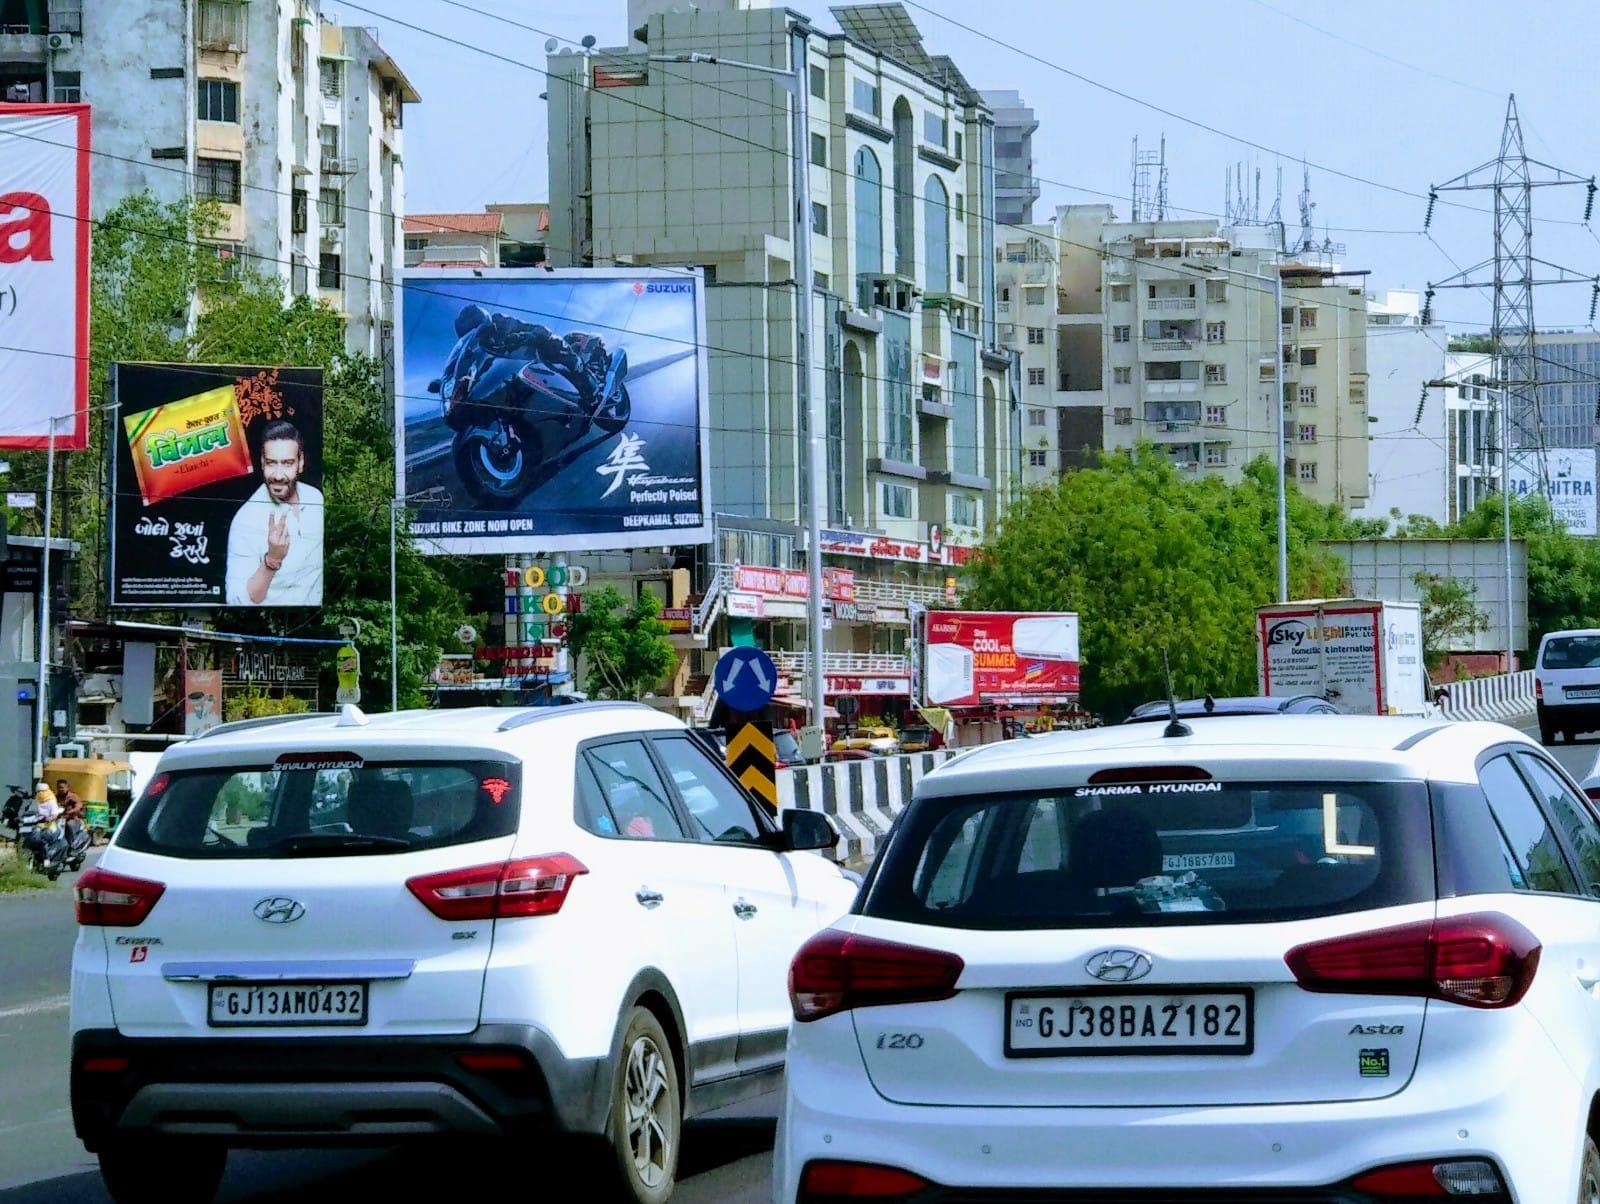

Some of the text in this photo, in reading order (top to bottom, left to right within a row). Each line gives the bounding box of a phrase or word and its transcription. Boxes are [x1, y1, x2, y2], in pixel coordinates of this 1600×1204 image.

[646, 284, 691, 293] SUZUKI
[596, 432, 650, 500] 隼
[631, 489, 697, 503] Perfectly Poised
[409, 519, 533, 534] SUZUKI BIKE ZONE NOW OPEN
[623, 514, 673, 527] DEEPKAMAL
[1275, 628, 1305, 647] Sky
[973, 638, 1000, 652] COOL
[239, 653, 276, 680] RAJPATH
[974, 653, 1017, 667] SUMMER
[272, 760, 364, 771] SHIVALIK HYUNDAI
[1074, 782, 1221, 797] SHARMA HYUNDAI
[1322, 793, 1376, 856] L
[227, 990, 361, 1015] GJ13AM0432
[1015, 1018, 1033, 1028] IND
[1038, 1004, 1241, 1038] GJ38BA2182
[1349, 1024, 1405, 1035] Asta
[1361, 1056, 1387, 1067] No.1
